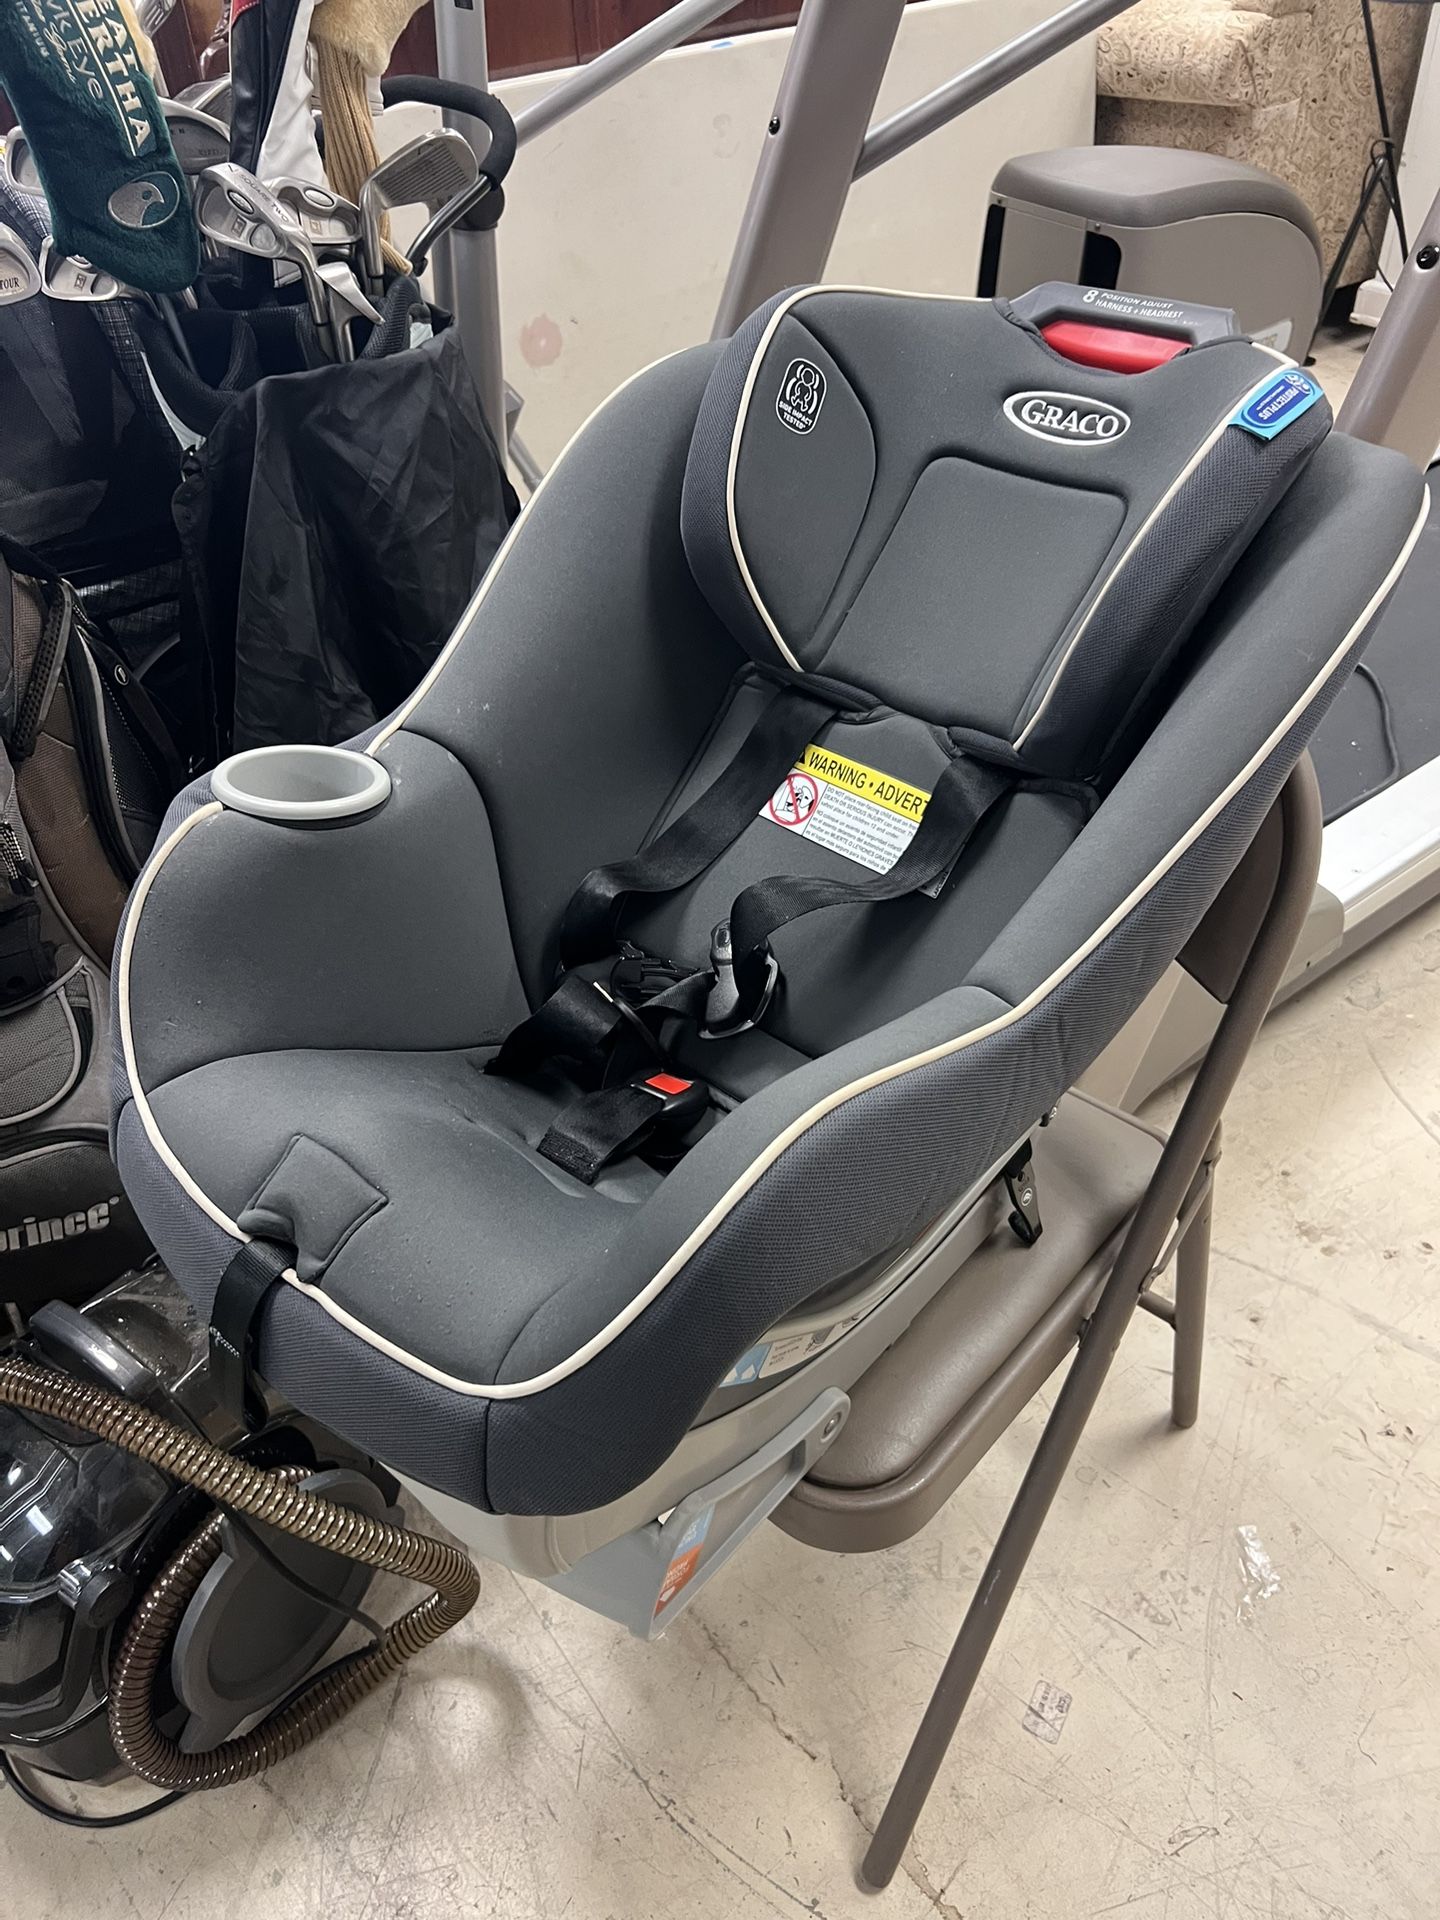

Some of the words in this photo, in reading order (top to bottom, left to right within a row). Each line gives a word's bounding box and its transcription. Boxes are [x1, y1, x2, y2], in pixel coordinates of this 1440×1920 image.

[67, 37, 103, 100] Eye
[271, 203, 289, 222] TWO
[1083, 289, 1099, 303] 8
[1101, 292, 1139, 305] POSITION
[1140, 299, 1173, 310] ADJUST
[1095, 300, 1132, 314] HARNESS
[1139, 308, 1184, 319] HEADREST
[779, 400, 793, 414] SIDE
[1021, 399, 1119, 437] GRACO
[808, 751, 868, 789] WARNING
